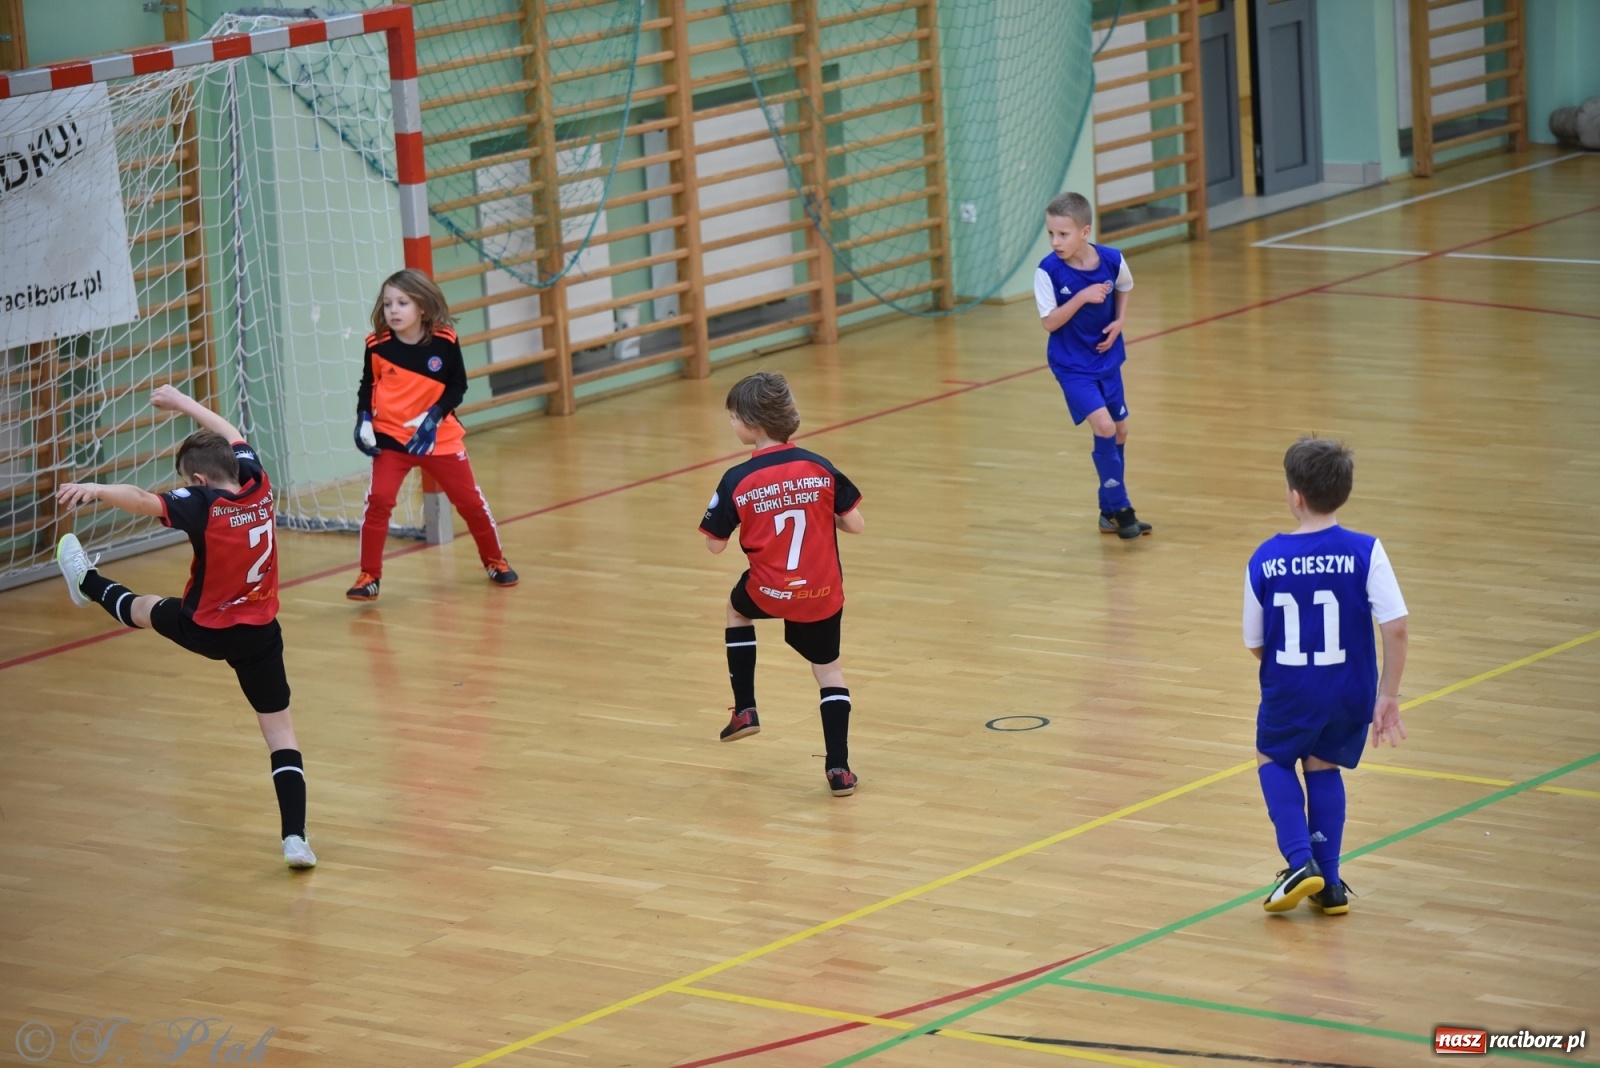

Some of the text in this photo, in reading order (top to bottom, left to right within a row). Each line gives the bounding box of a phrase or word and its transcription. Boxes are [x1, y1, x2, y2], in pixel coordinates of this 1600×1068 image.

[0, 270, 102, 313] aciborz.pl
[736, 477, 831, 507] AKADEMIA PIŁKARSKA
[753, 498, 783, 514] GÓRKI
[229, 512, 257, 528] GÓRKI
[246, 519, 273, 584] 2
[774, 509, 807, 571] 7
[1262, 554, 1355, 579] UKS CIESZYN
[1273, 590, 1346, 666] 11
